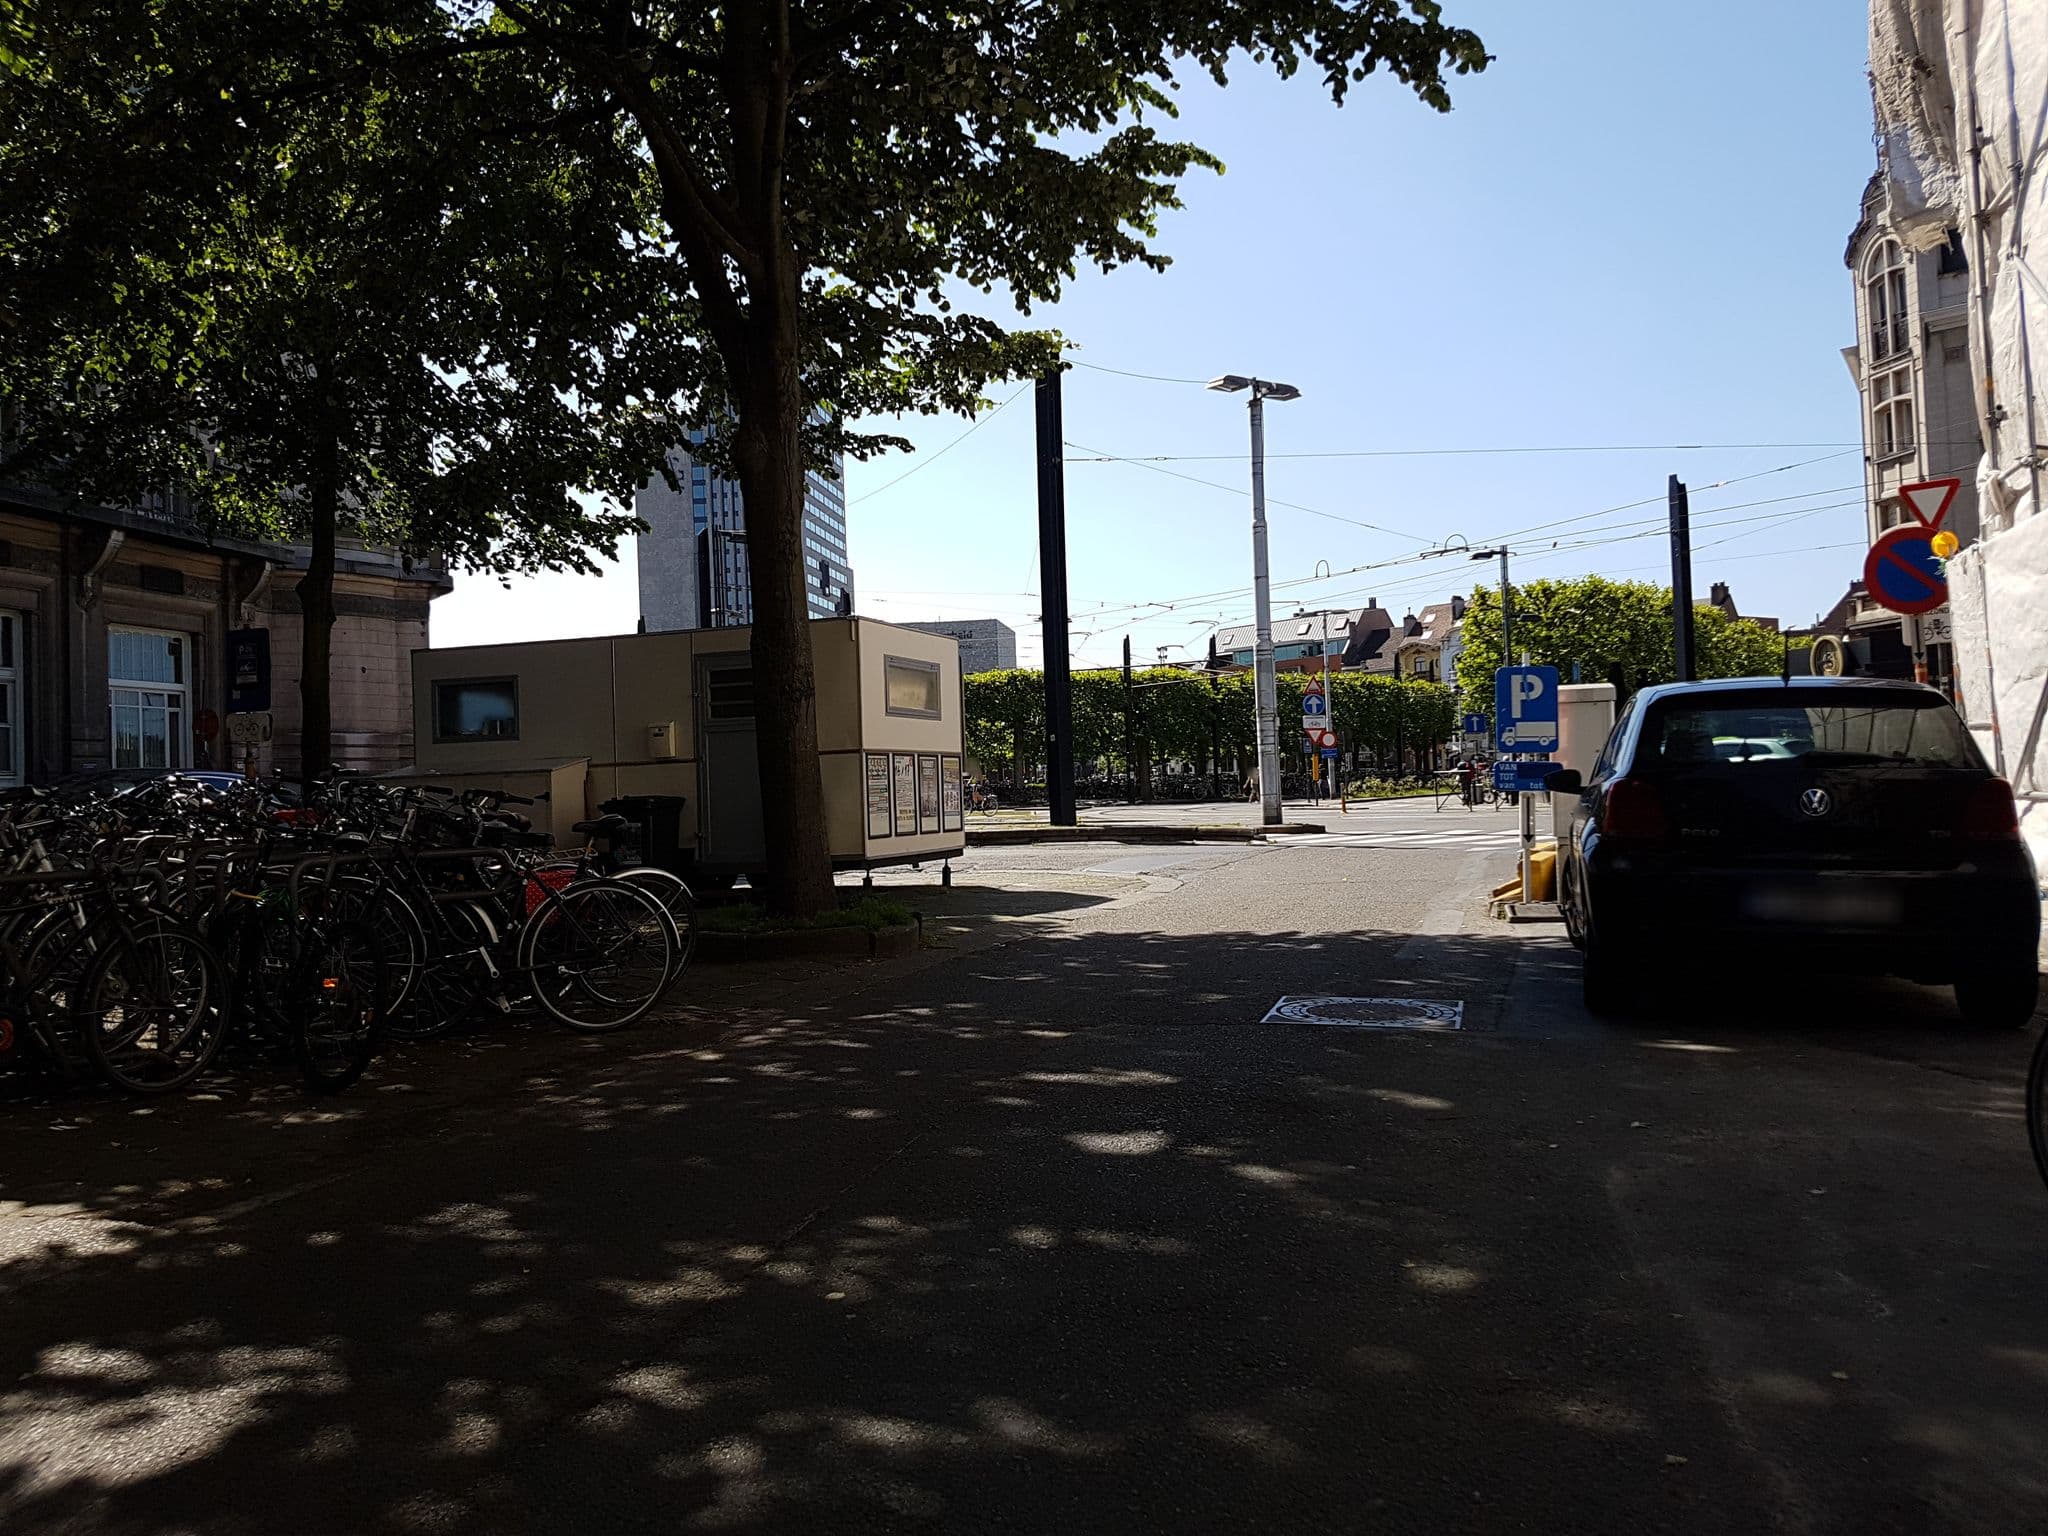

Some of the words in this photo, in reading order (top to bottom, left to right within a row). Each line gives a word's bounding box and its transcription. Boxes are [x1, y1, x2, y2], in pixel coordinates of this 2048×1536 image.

[1510, 674, 1544, 719] P
[1498, 763, 1518, 771] VAN
[1498, 773, 1515, 781] TOT
[1680, 828, 1721, 838] POLO
